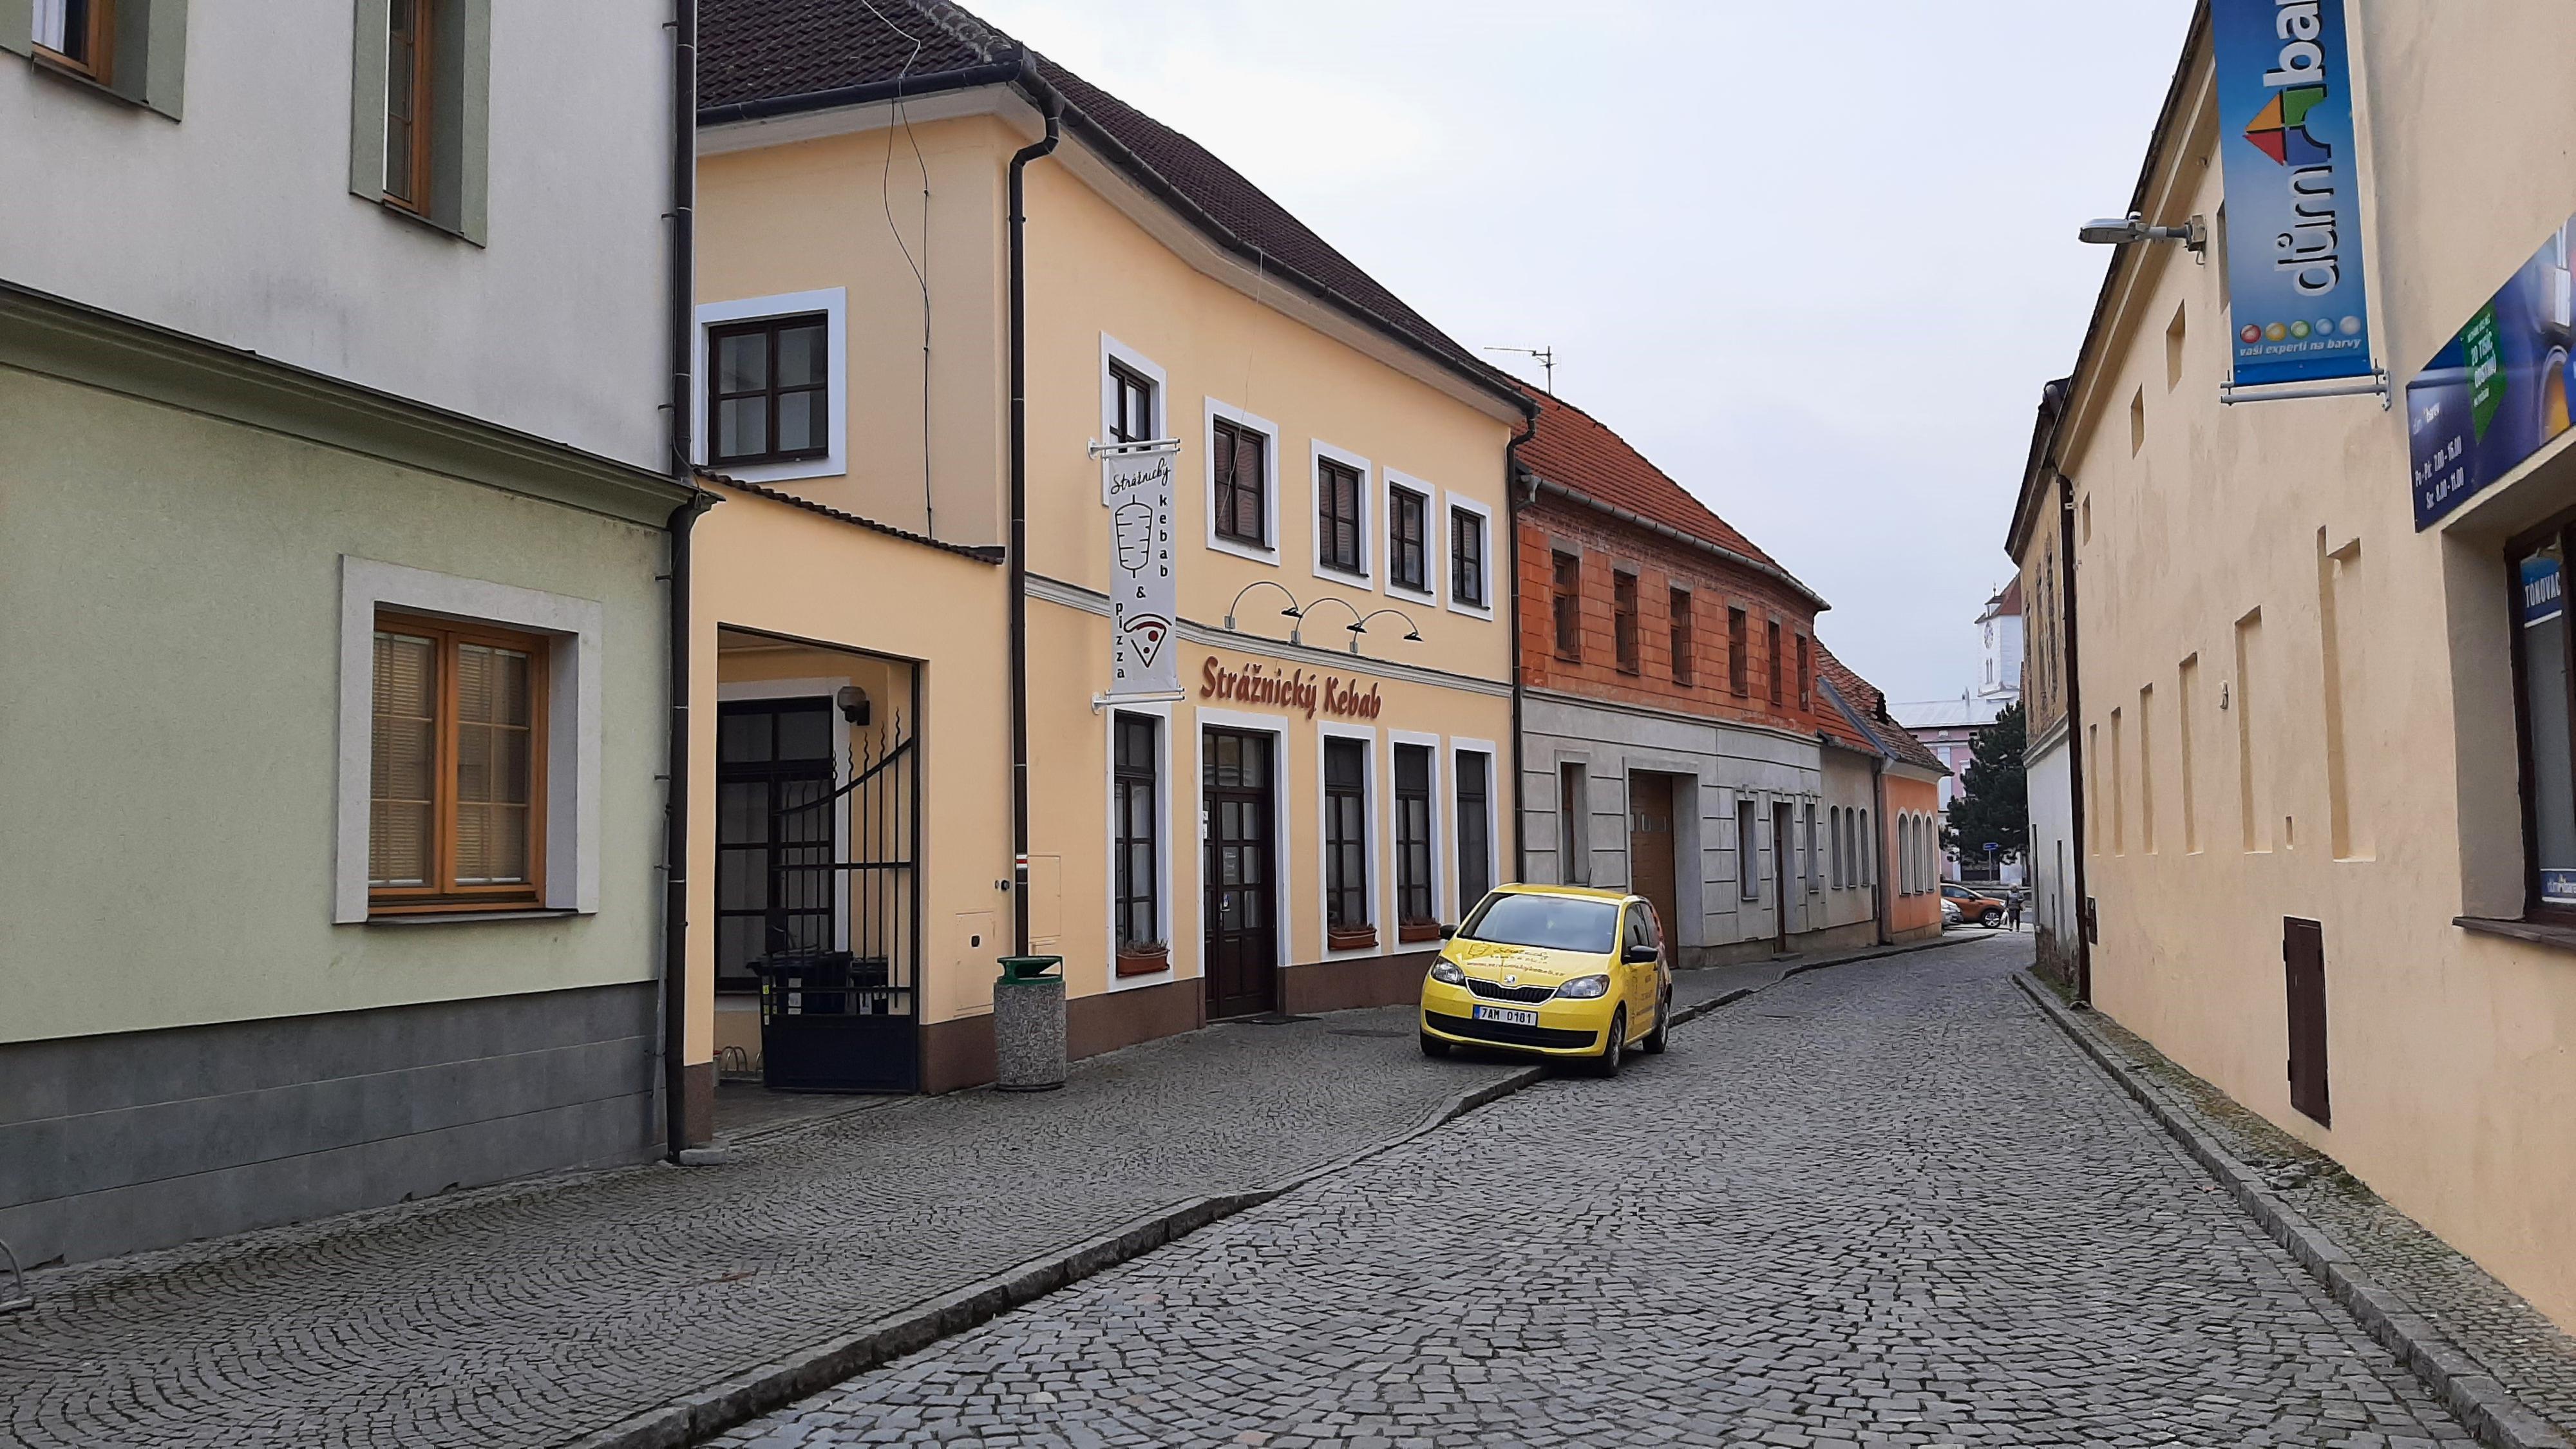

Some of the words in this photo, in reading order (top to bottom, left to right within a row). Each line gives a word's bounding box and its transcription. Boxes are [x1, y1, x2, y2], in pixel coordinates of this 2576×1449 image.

[2262, 0, 2324, 87] ba
[2274, 166, 2341, 297] dům
[2240, 344, 2262, 356] vaši
[2266, 341, 2307, 355] experti
[2310, 341, 2324, 350] na
[2327, 338, 2362, 350] barvy
[1136, 586, 1146, 598] &
[1200, 656, 1318, 720] Strážnický
[1324, 676, 1381, 719] Kebab
[1482, 1008, 1500, 1020] 7AM
